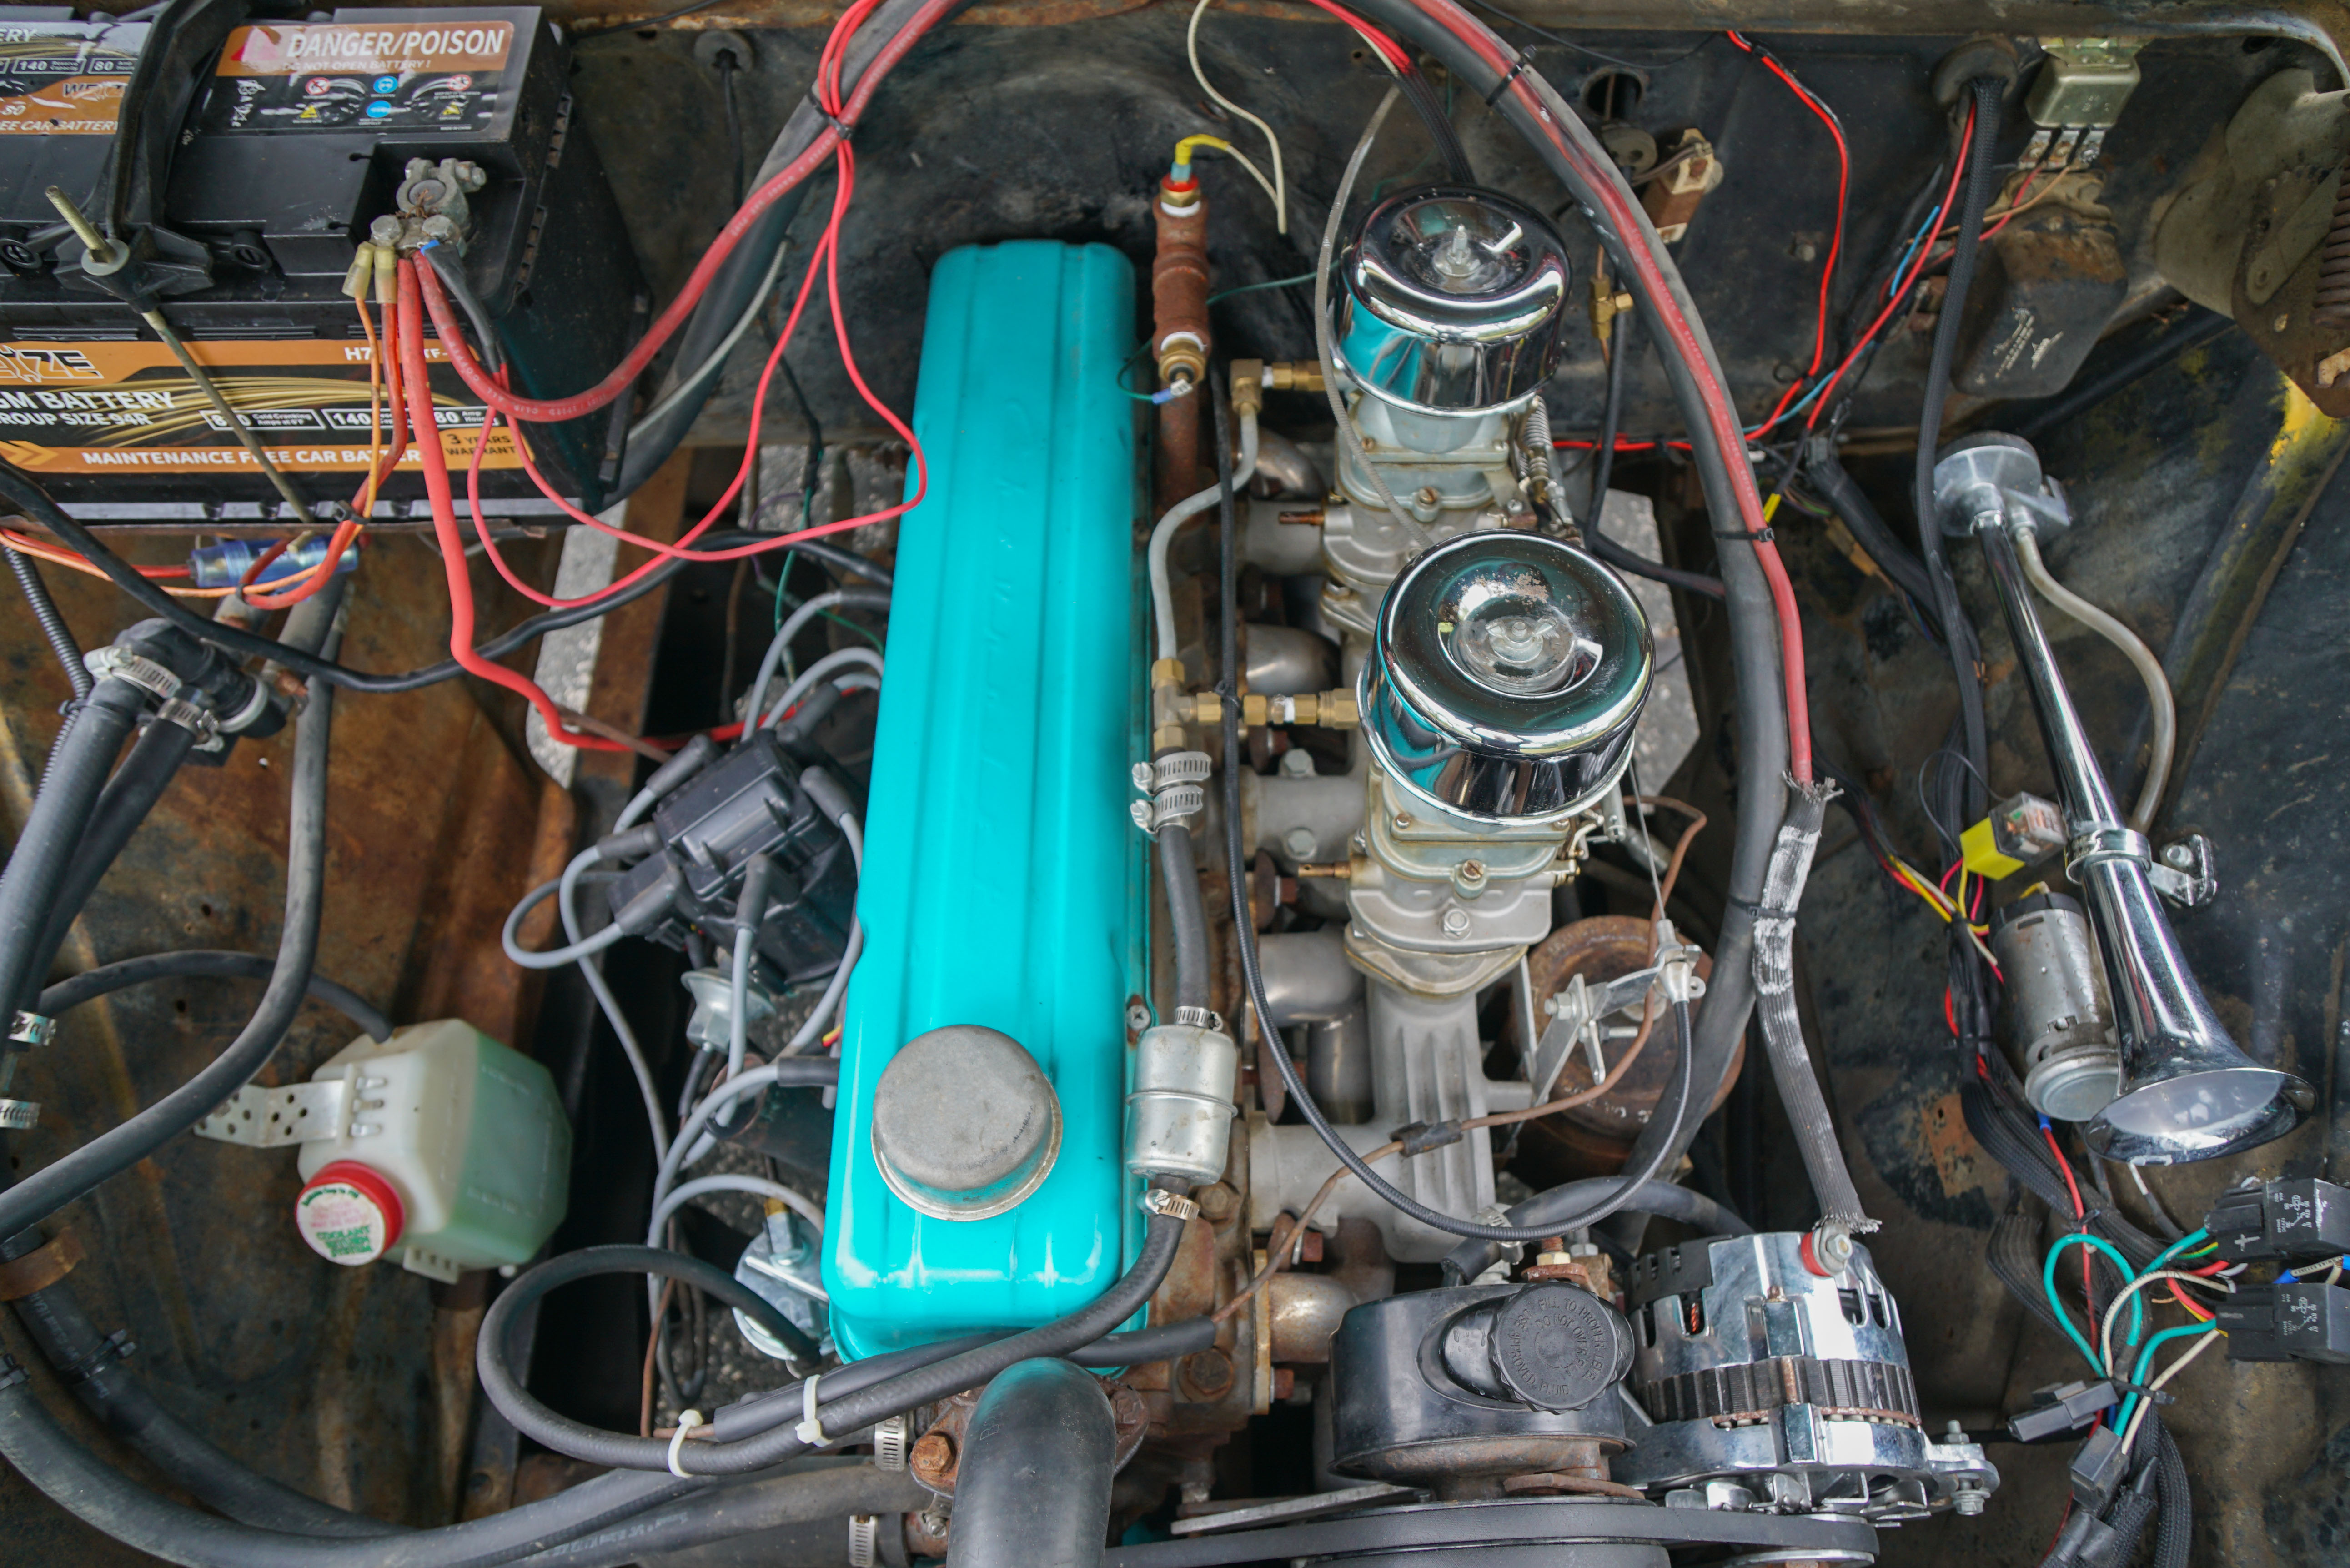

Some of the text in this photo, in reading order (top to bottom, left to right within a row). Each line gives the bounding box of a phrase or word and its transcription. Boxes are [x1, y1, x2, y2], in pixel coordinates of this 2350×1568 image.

[286, 29, 504, 57] DANGER/POISON
[20, 61, 47, 71] 140
[94, 61, 114, 71] 80
[304, 61, 327, 70] NOT
[331, 61, 368, 70] OPEN
[370, 60, 425, 70] BATTERY
[0, 121, 118, 131] EE CAR BATTER
[34, 392, 175, 409] BATTERY
[0, 413, 154, 425] ROUP SIZE 94R
[211, 414, 251, 426] 80
[333, 413, 372, 425] 140
[433, 411, 460, 423] 80
[447, 434, 461, 444] 3
[446, 446, 515, 455] WARANT
[82, 452, 236, 465] MAINTENANCE
[295, 451, 338, 463] CAR
[1564, 1298, 1577, 1312] TO
[1578, 1307, 1606, 1349] PROPER
[1535, 1315, 1551, 1330] DO
[1553, 1313, 1575, 1328] NOT
[1572, 1327, 1588, 1356] OVER
[1509, 1329, 1536, 1384] APPROVED
[1539, 1380, 1569, 1395] FLUID
